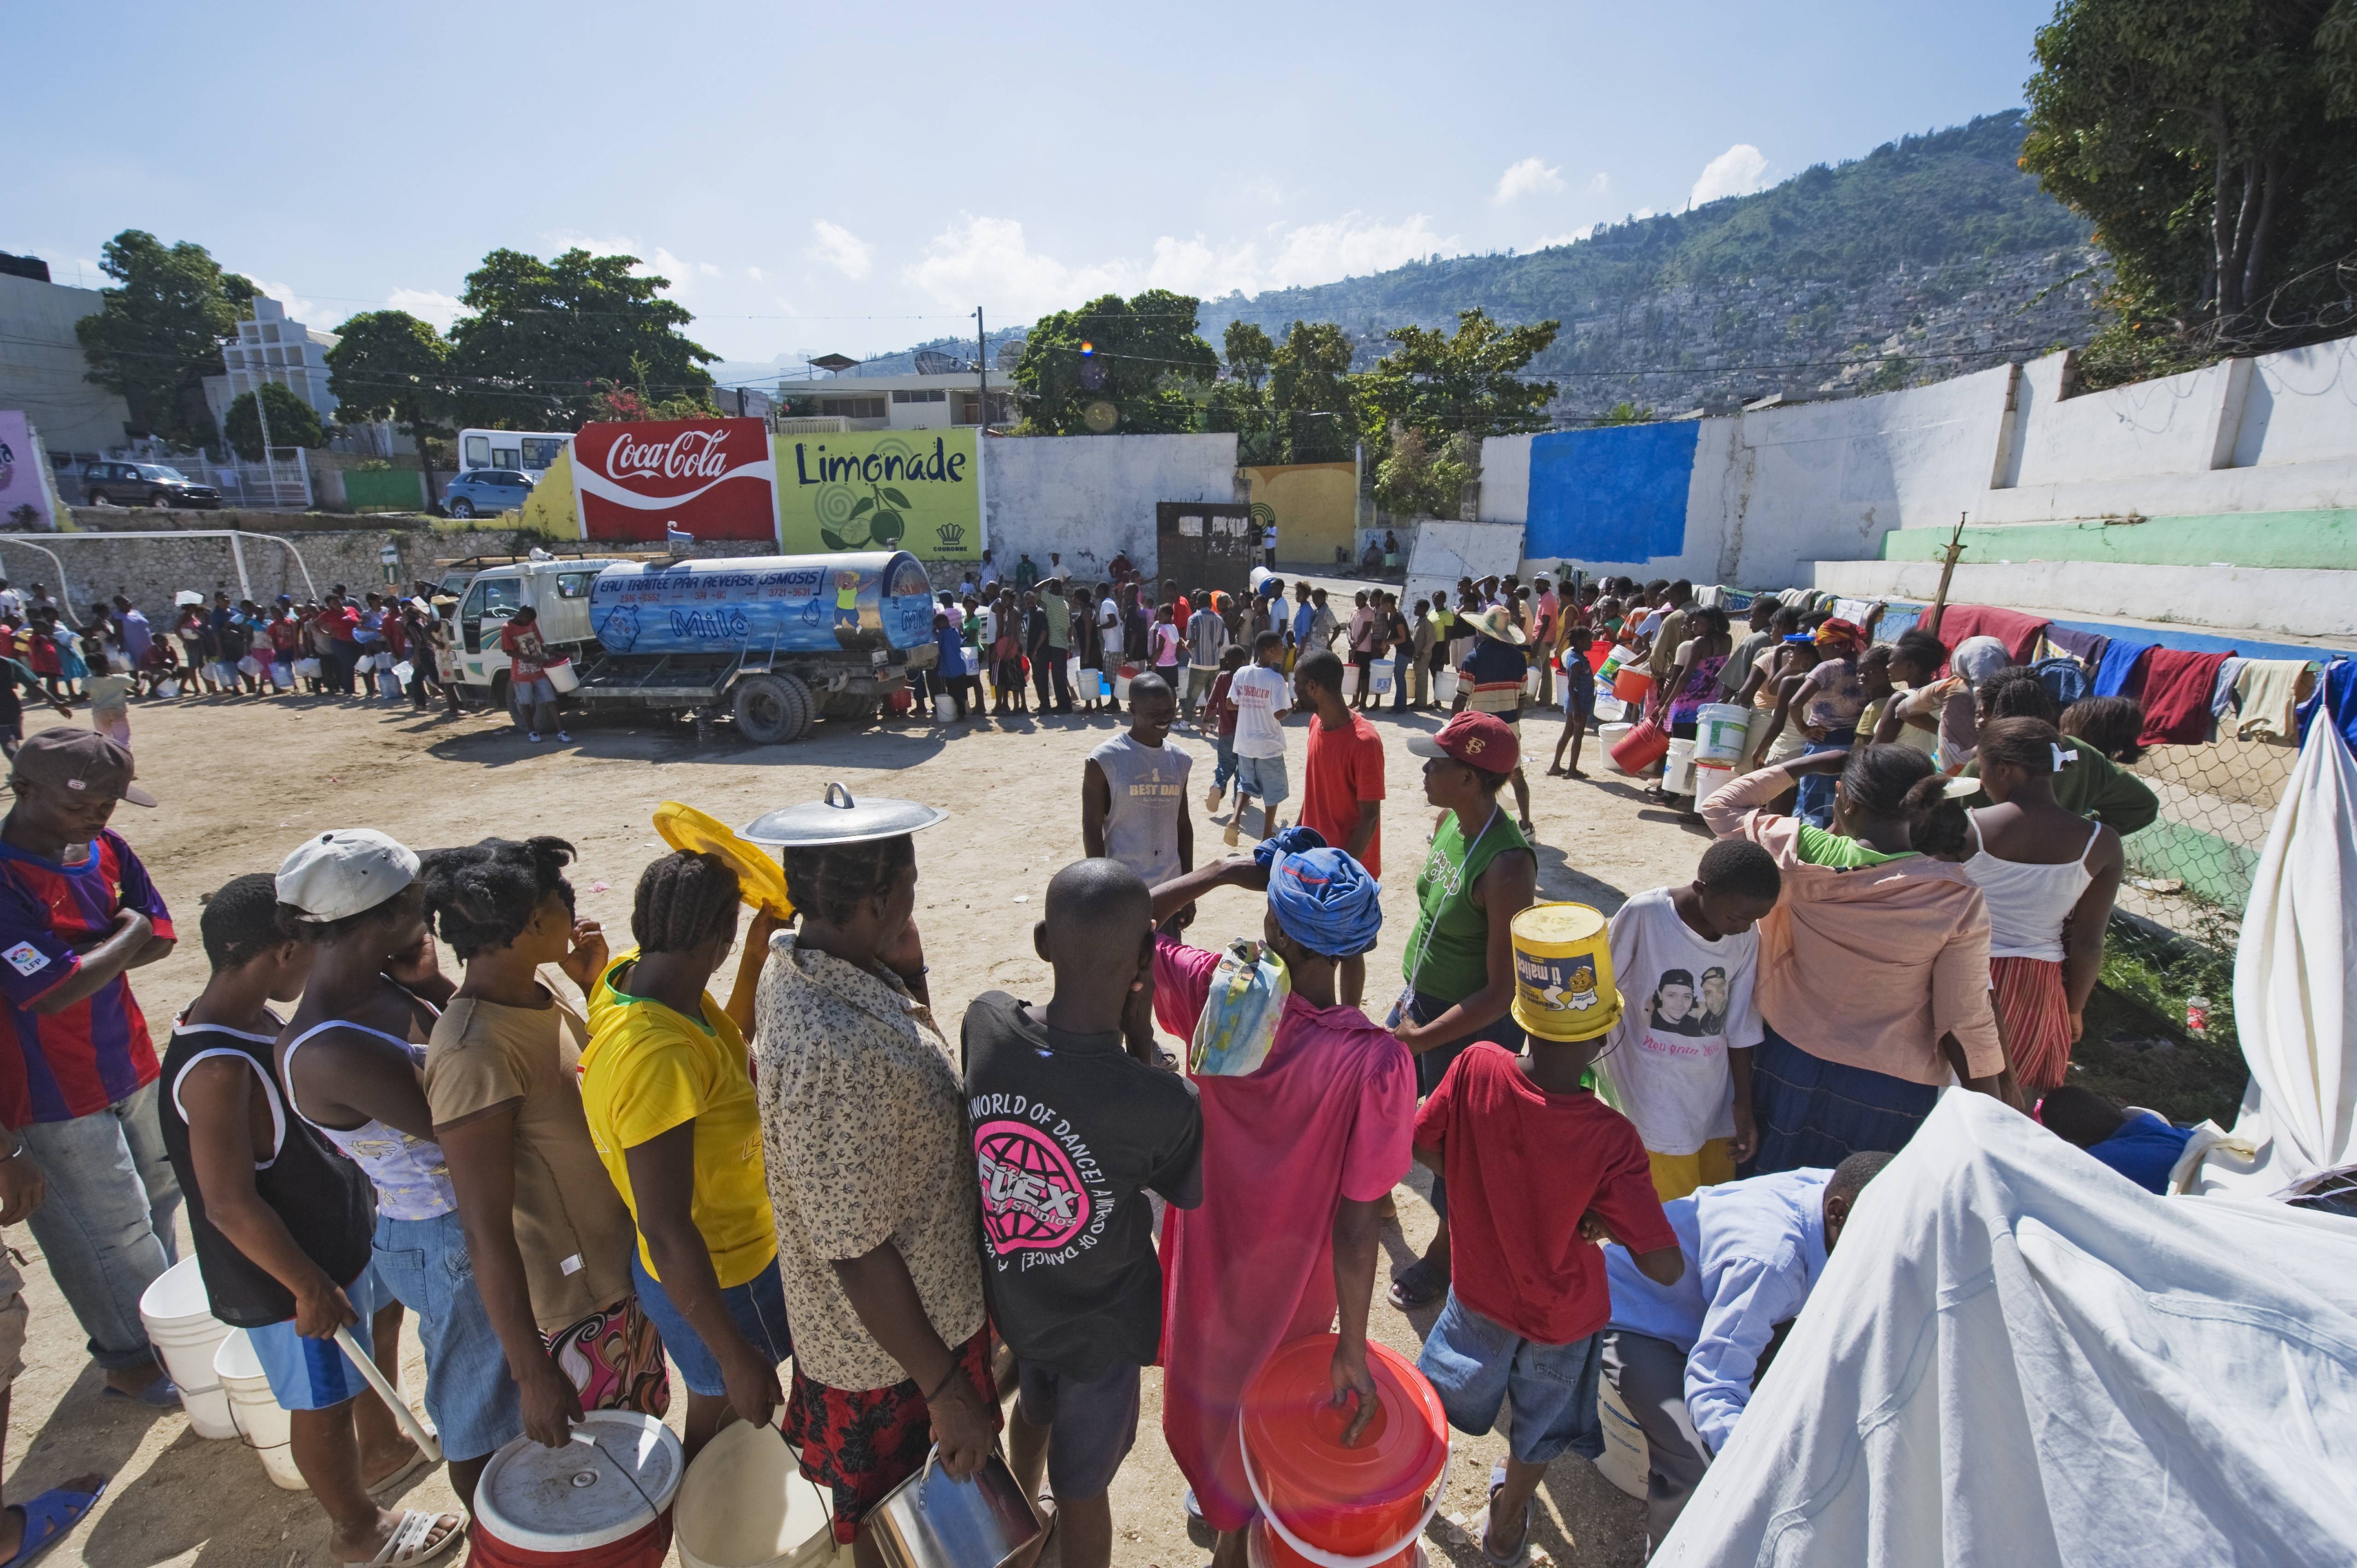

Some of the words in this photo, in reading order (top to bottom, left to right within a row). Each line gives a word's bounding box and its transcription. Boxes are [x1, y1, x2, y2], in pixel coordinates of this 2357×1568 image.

[606, 429, 731, 479] Coca-Cola
[795, 436, 966, 486] Limonade
[600, 580, 624, 593] EAU
[627, 578, 669, 591] TRAITEE
[673, 577, 699, 590] PAR
[702, 575, 755, 588] REVERSE
[759, 571, 817, 585] OSMOSIS
[1129, 784, 1158, 796] BEST
[1160, 784, 1179, 796] DAD
[23, 959, 41, 971] LFP
[1551, 967, 1562, 985] ti
[970, 1093, 1027, 1119] WORLD
[1030, 1103, 1056, 1124] OF
[1052, 1119, 1106, 1184] DANCE!
[978, 1150, 1081, 1218] FLEX
[1011, 1200, 1077, 1227] STUDIOS
[1078, 1234, 1097, 1250] OF
[1022, 1246, 1079, 1273] DANCE!
